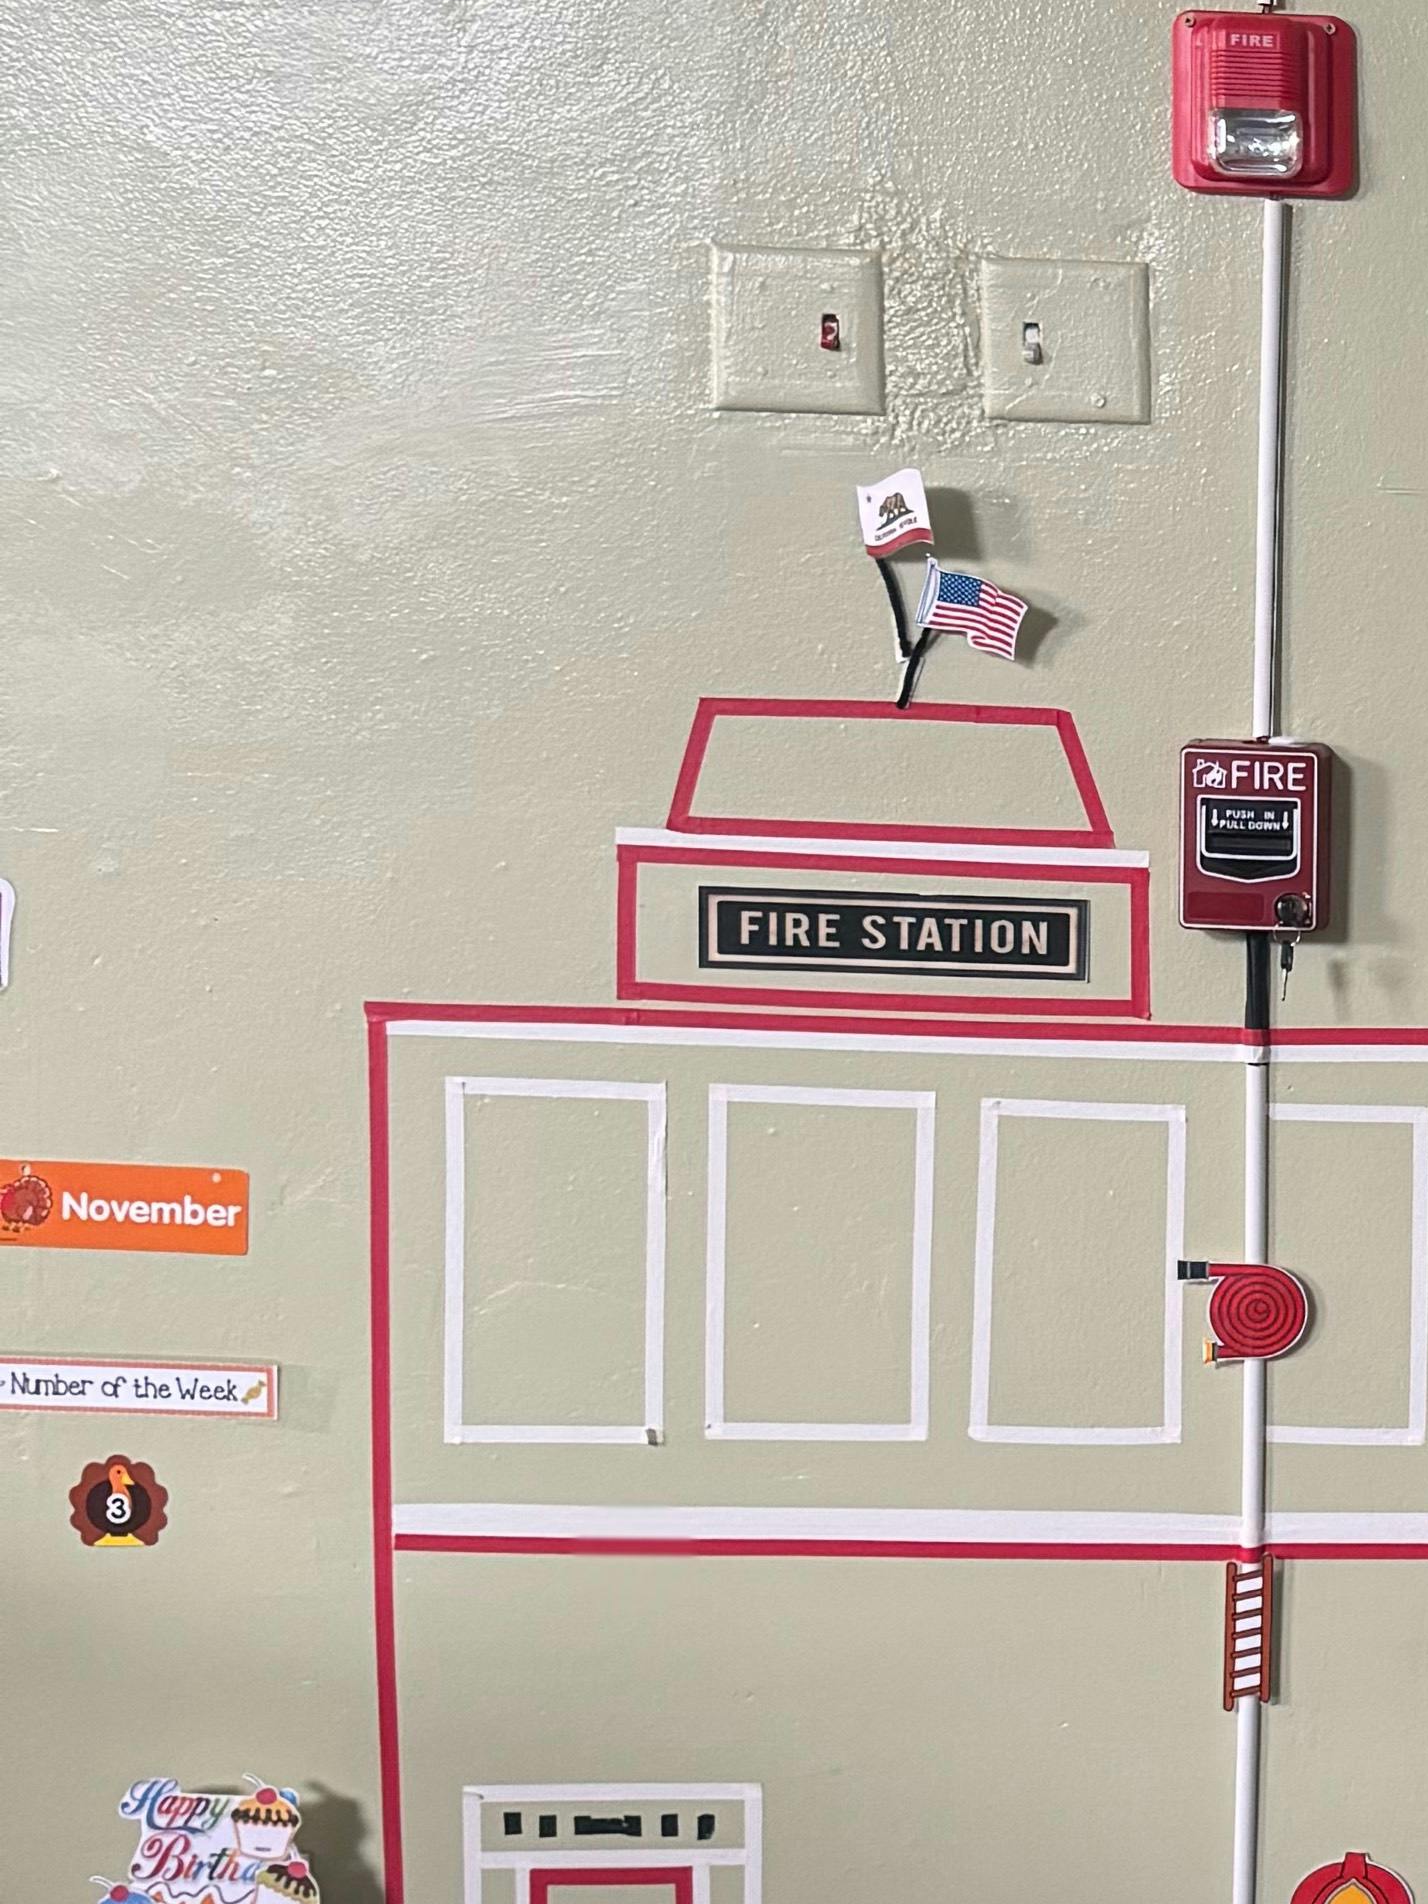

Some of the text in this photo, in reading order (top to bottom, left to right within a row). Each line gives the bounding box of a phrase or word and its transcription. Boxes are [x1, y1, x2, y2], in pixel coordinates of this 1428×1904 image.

[1229, 33, 1274, 48] FIRE
[1230, 759, 1307, 791] FIRE
[1219, 819, 1281, 831] PULL DOWN
[1225, 809, 1275, 820] PUSH IN
[738, 909, 1048, 955] FIRE STATION
[61, 1191, 242, 1227] November
[11, 1371, 239, 1403] Number of the Week
[109, 1496, 128, 1520] 3
[120, 1778, 230, 1834] Happy
